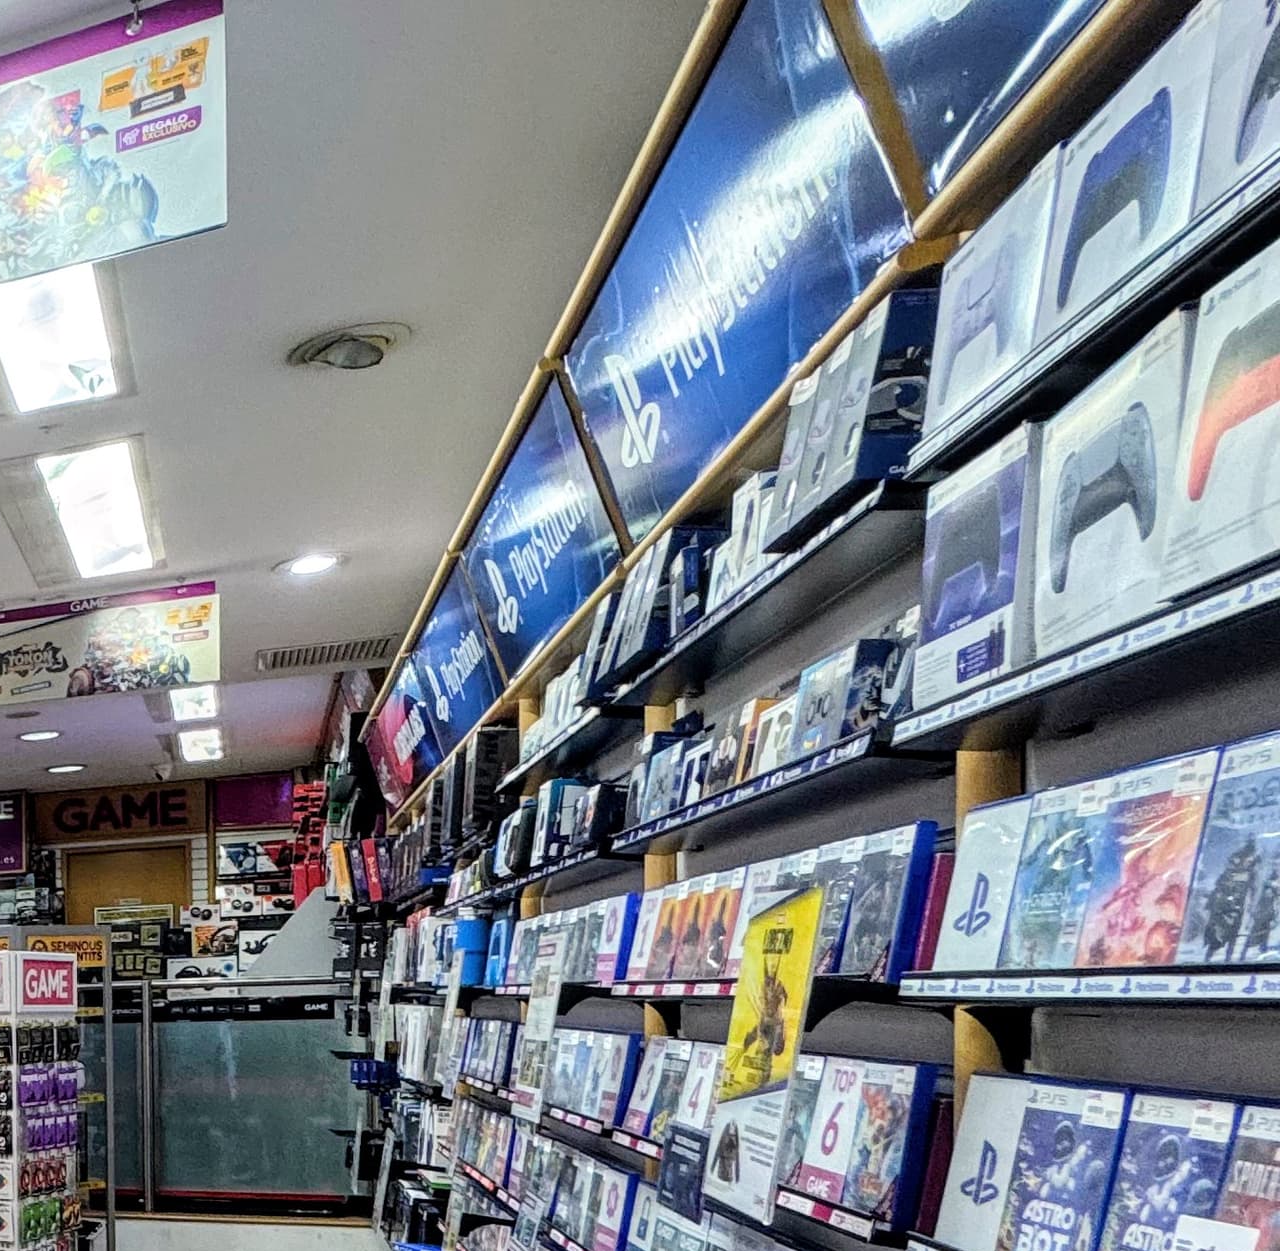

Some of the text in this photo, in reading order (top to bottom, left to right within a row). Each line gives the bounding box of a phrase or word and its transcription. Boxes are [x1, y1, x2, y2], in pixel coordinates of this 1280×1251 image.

[142, 113, 189, 134] REGALO
[142, 120, 197, 140] EXCLUSIVO
[508, 475, 593, 599] PlayStation
[70, 597, 110, 613] GAME
[53, 789, 188, 834] GAME
[51, 941, 102, 951] SEMINOUS
[25, 968, 68, 999] GAME
[304, 1003, 329, 1012] GAME
[832, 1067, 856, 1092] TOP
[820, 1112, 841, 1156] 6
[806, 1175, 830, 1197] GAME
[1022, 1201, 1074, 1230] ASTRO
